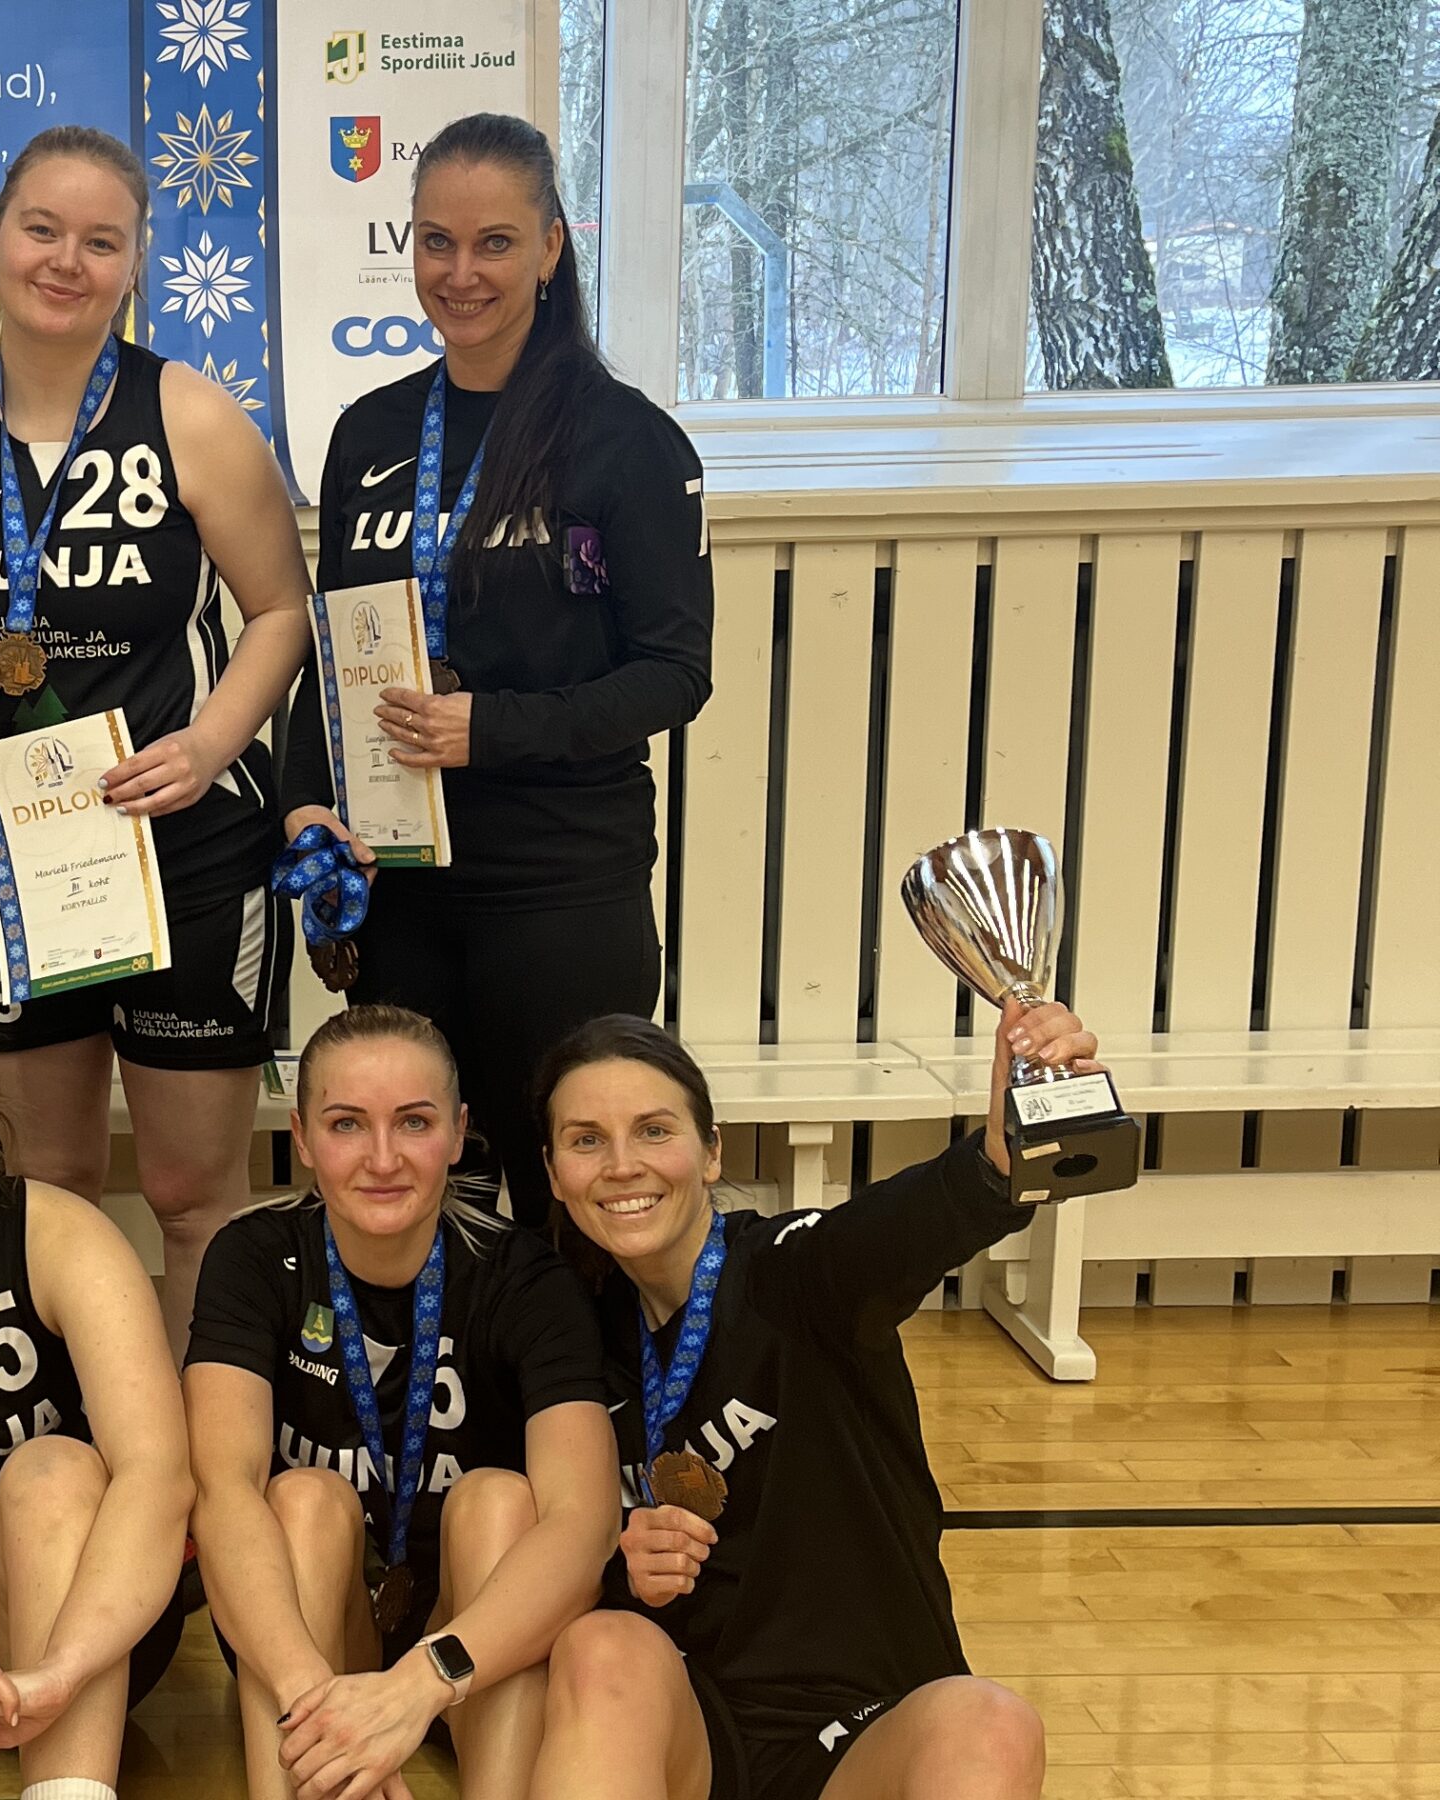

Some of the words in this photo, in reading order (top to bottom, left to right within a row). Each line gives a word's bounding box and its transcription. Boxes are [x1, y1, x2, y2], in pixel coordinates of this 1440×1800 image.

[380, 32, 465, 50] Eestimaa
[380, 53, 466, 74] Spordiliit
[469, 50, 516, 69] Jõud
[59, 443, 170, 531] 28
[85, 630, 107, 643] JA
[46, 641, 131, 660] JAKESKUS
[343, 661, 405, 688] DIPLOM
[69, 851, 128, 873] Friedemann
[132, 1008, 179, 1021] LUUNJA
[203, 1018, 219, 1029] JA
[133, 1025, 235, 1039] VABAAJAKESKUS
[288, 1350, 340, 1386] ALDING
